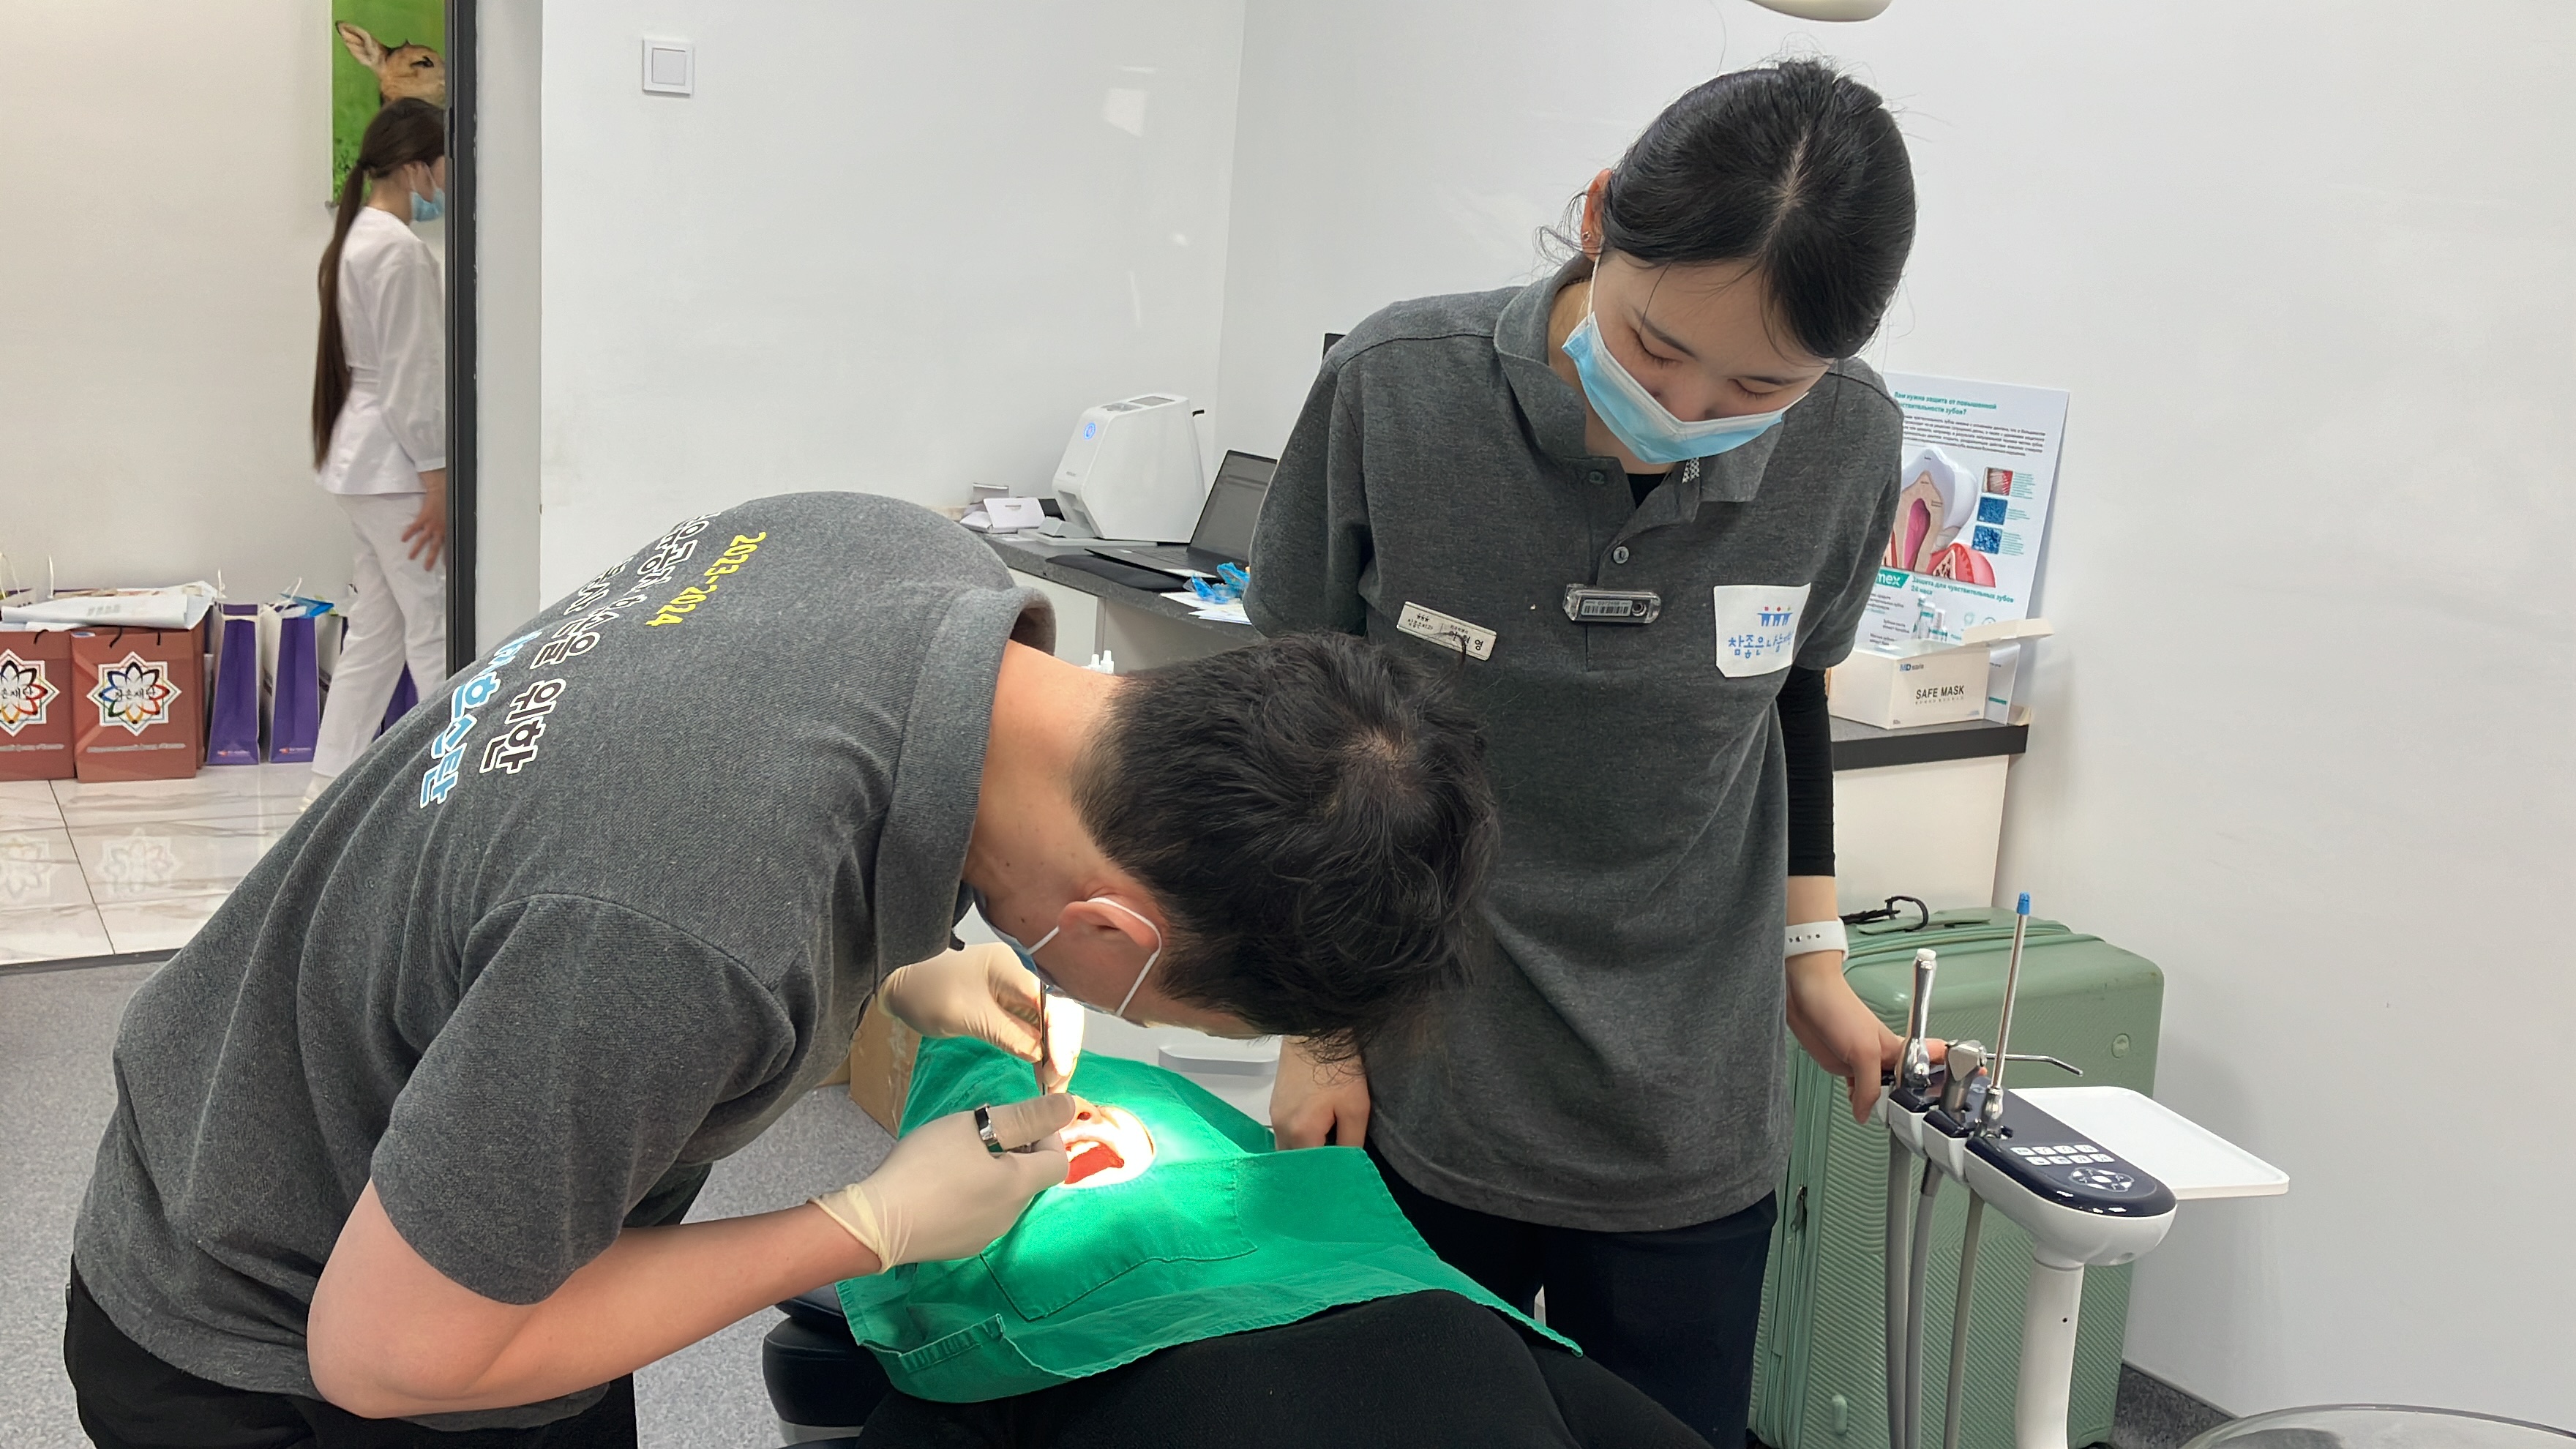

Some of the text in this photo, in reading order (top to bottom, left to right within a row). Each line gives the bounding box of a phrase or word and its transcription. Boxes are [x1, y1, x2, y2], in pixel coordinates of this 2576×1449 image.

[645, 531, 766, 626] 2023-2024
[1877, 573, 1901, 585] mex
[1912, 576, 1934, 586] Защита
[1996, 594, 2014, 603] зубов
[1915, 685, 1965, 700] SAFE MASK
[479, 678, 566, 774] 위한
